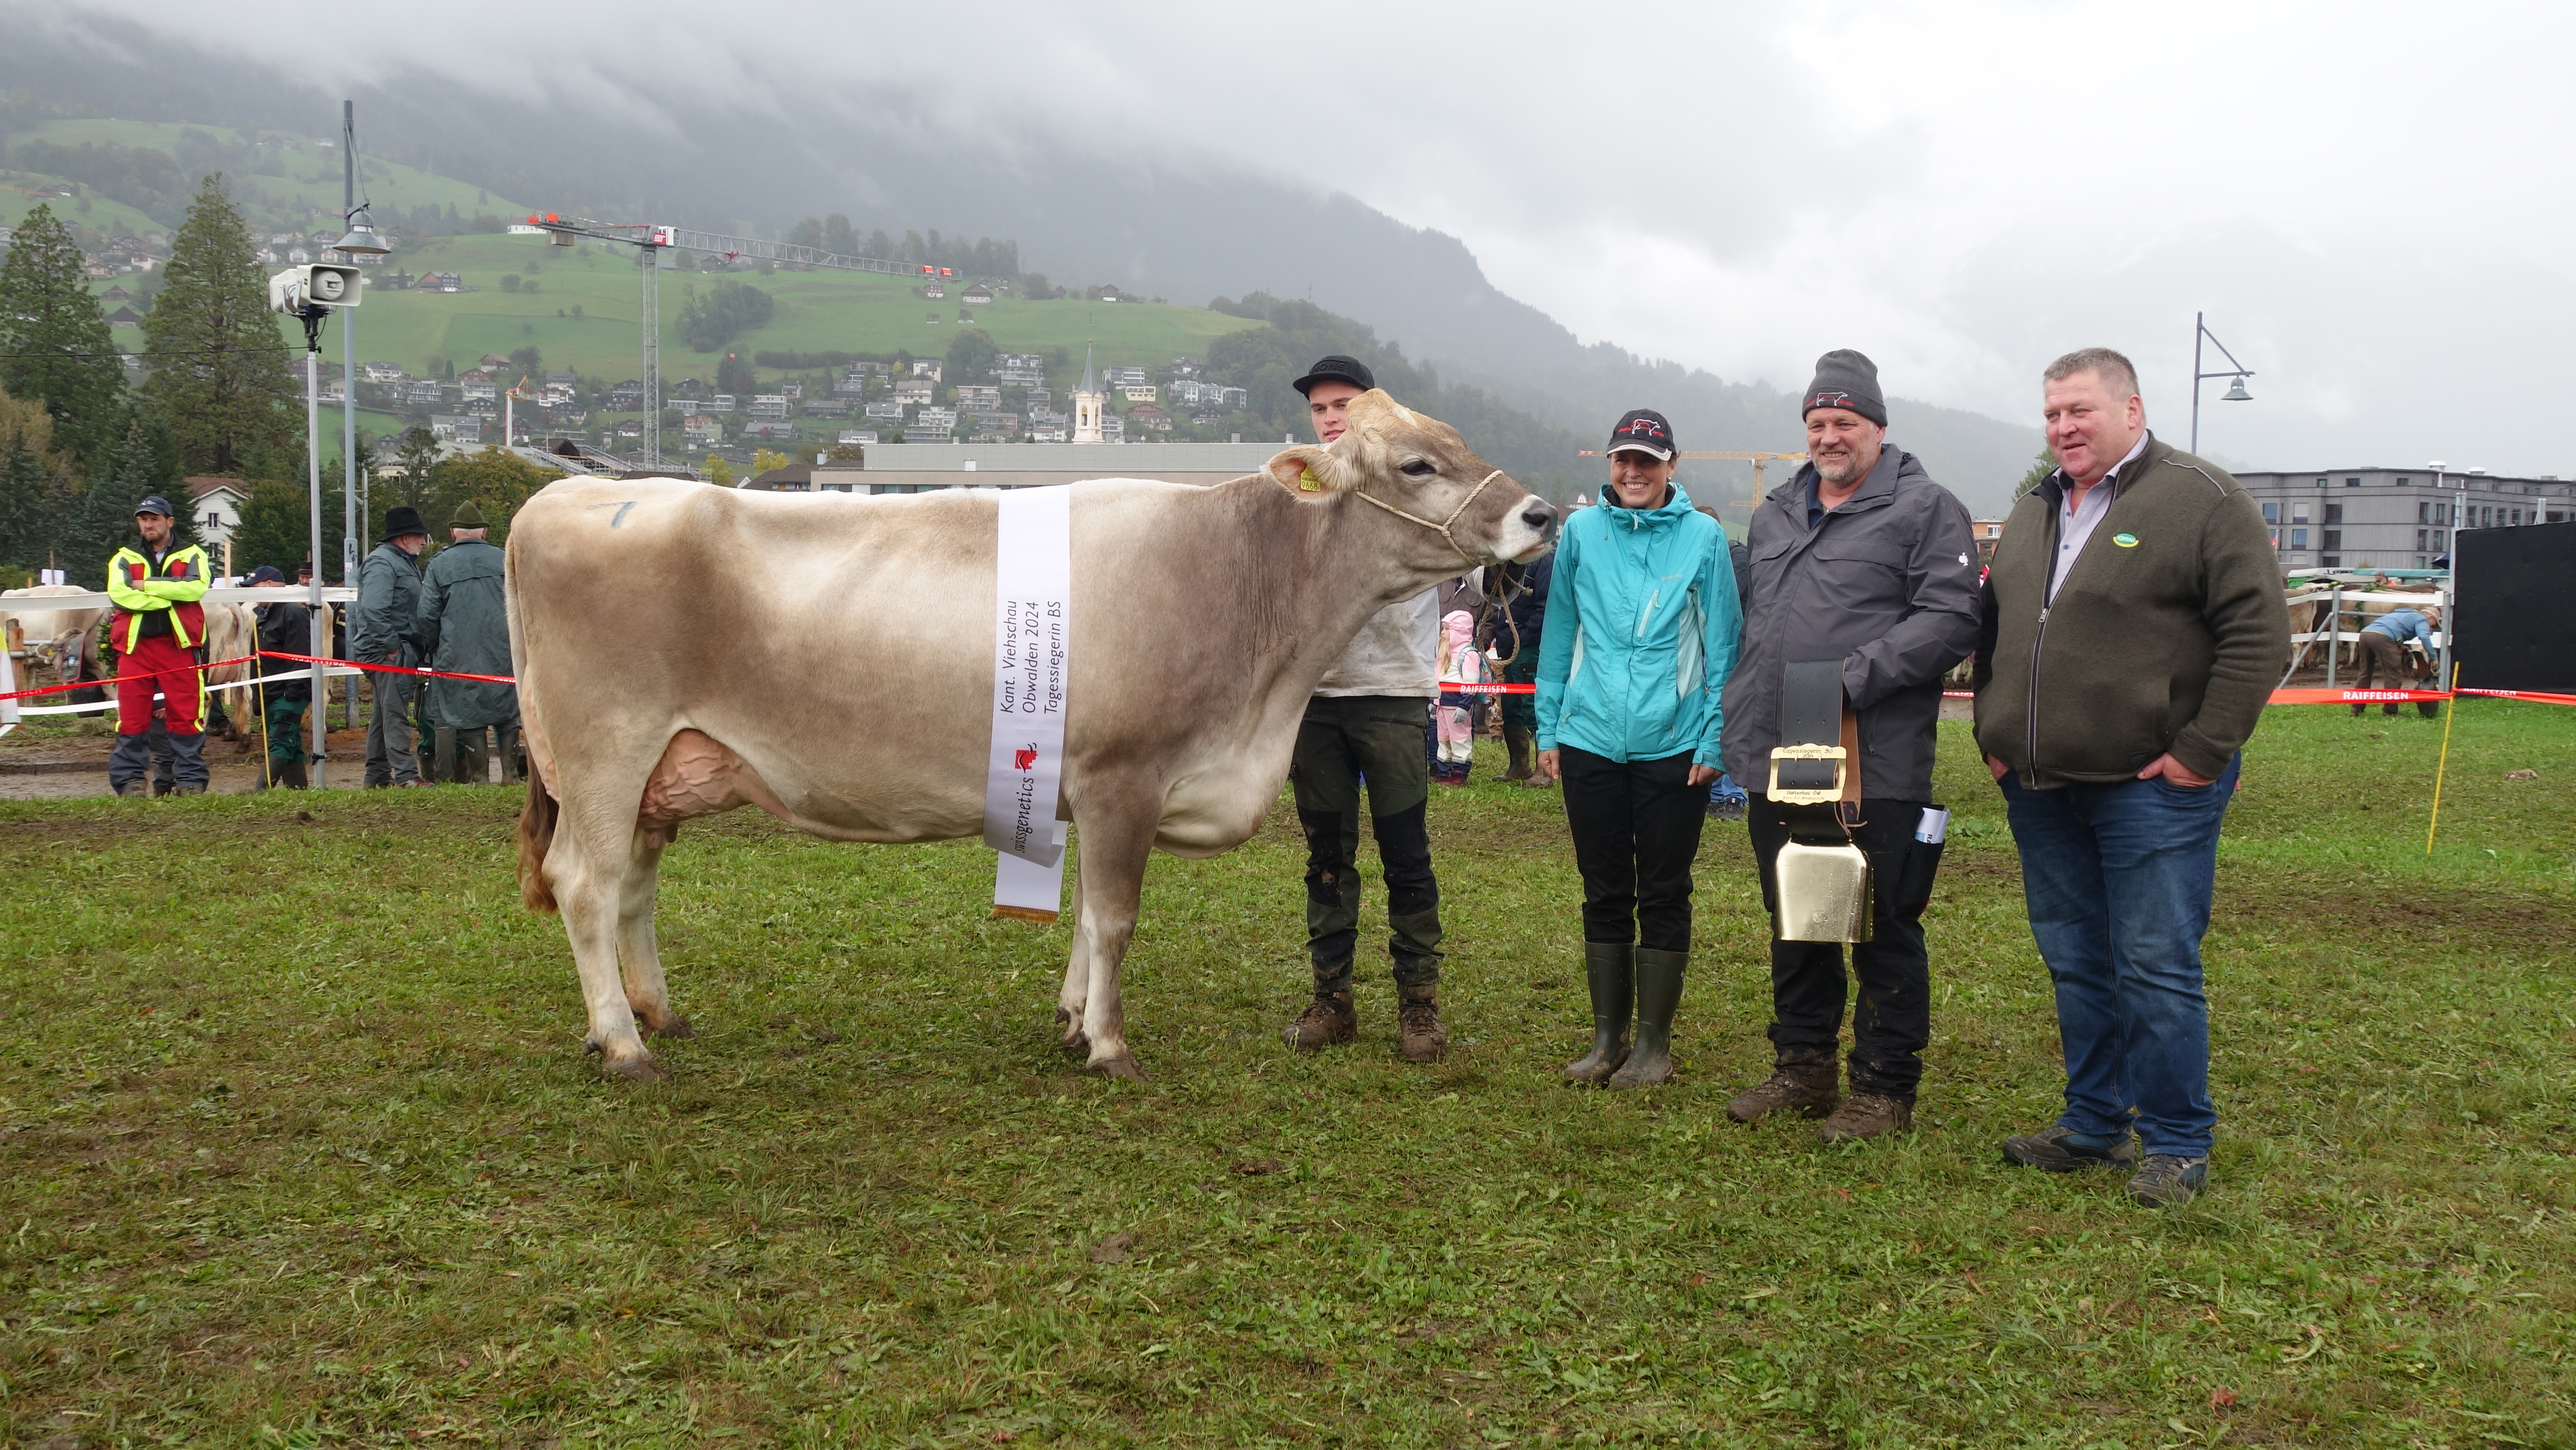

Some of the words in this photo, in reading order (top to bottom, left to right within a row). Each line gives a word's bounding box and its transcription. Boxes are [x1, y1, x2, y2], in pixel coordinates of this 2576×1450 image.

[1301, 481, 1318, 490] 9668
[1025, 602, 1038, 637] 2024
[1047, 601, 1061, 618] BS
[1002, 601, 1017, 669] Viehschau
[1022, 643, 1038, 713] Obwalden
[1044, 623, 1064, 714] Tagessiegerin
[1000, 676, 1015, 713] Kant.
[1460, 685, 1507, 693] RAIFFEISEN
[2343, 691, 2409, 700] RAIFFEISEN
[1011, 777, 1034, 853] swissgenetics
